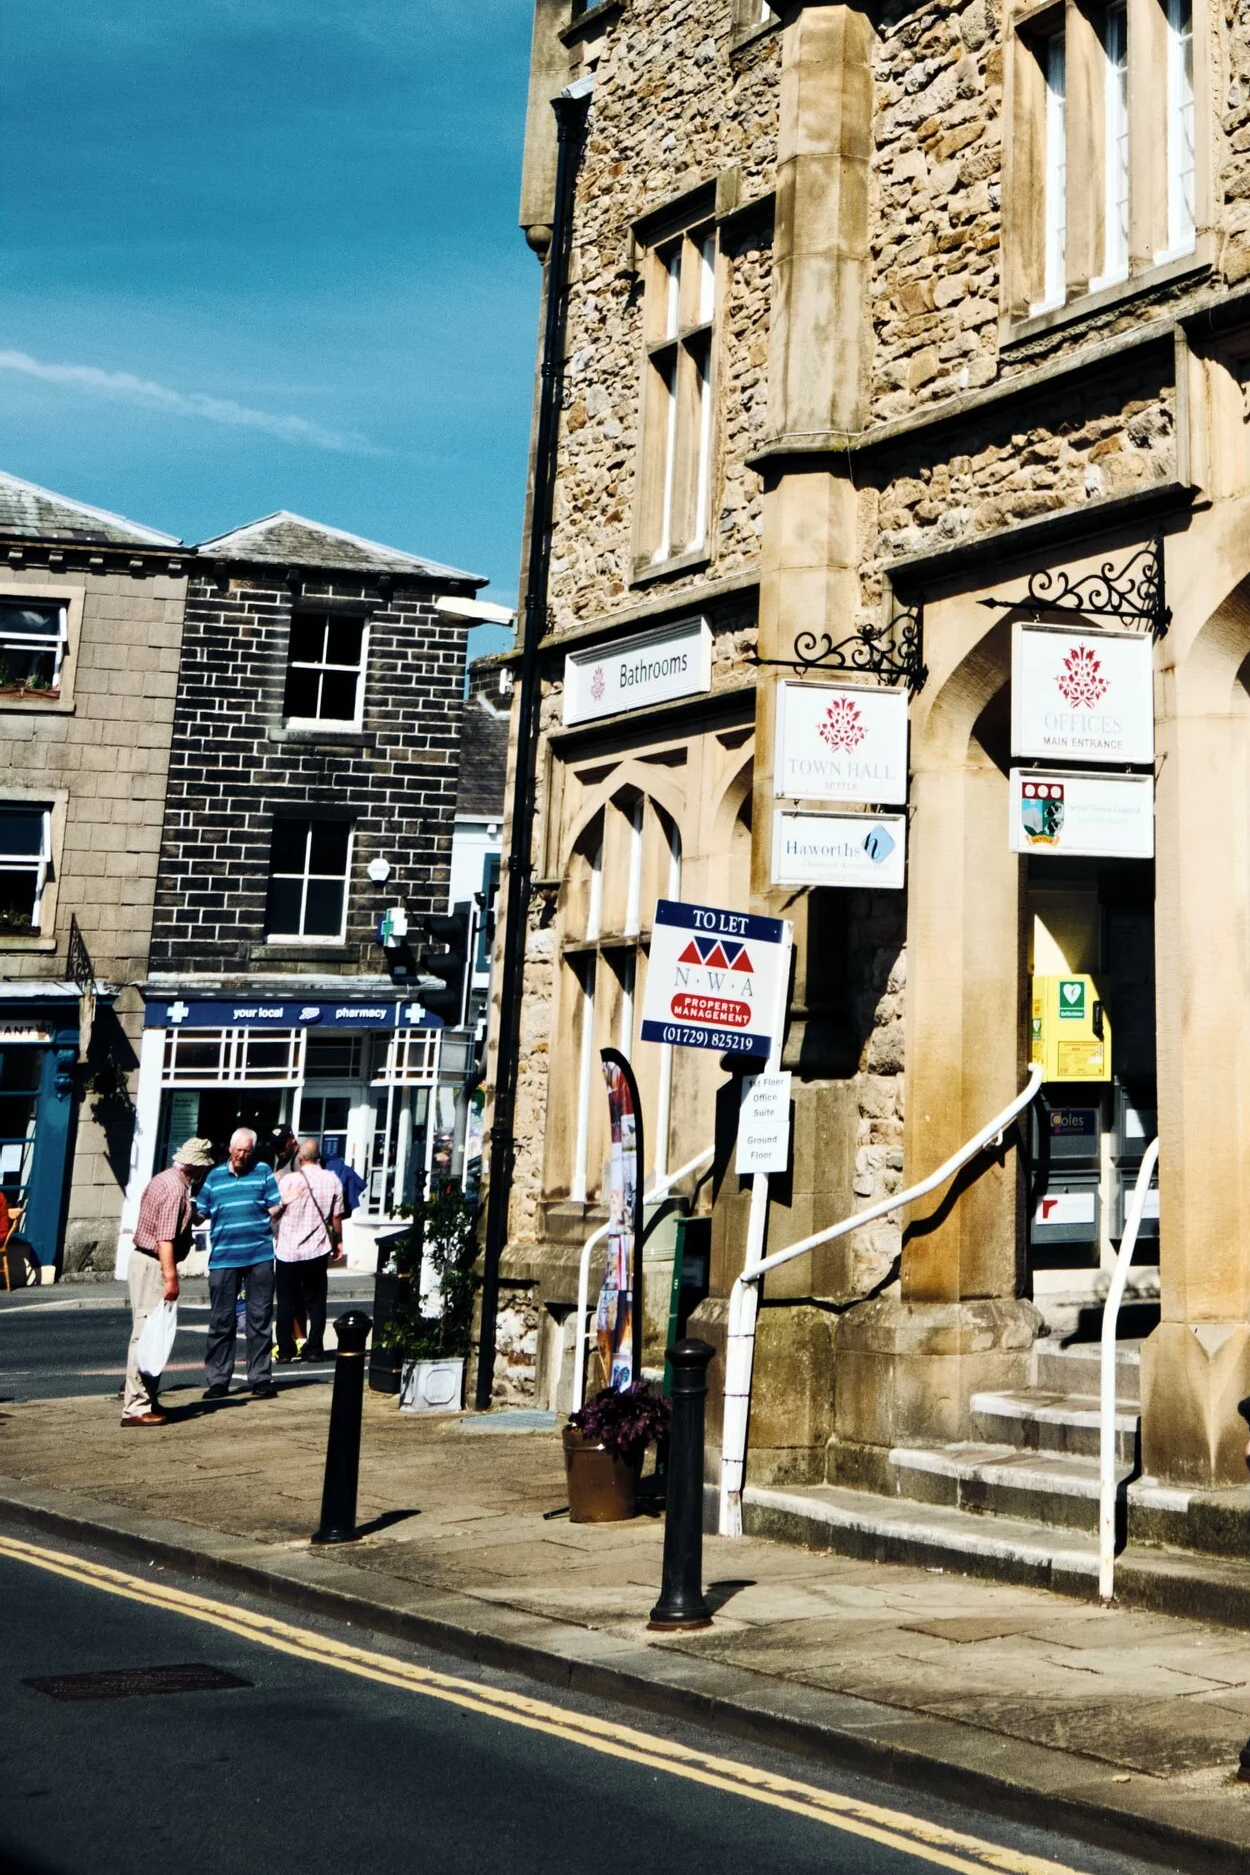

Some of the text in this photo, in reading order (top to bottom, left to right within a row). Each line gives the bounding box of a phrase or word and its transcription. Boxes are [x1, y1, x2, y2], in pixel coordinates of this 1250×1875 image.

[619, 653, 688, 689] Bathrooms
[1044, 712, 1122, 734] OFFICES
[1043, 736, 1124, 750] MAIN ENTRANCE
[788, 758, 896, 781] TOWN HALL
[785, 840, 861, 857] Haworths
[693, 910, 750, 934] TO LET
[684, 997, 742, 1012] PROPERTY
[233, 1007, 284, 1020] your local
[336, 1007, 387, 1020] pharmacy
[674, 1005, 749, 1024] MANAGEMENT
[0, 1025, 34, 1036] ANT
[662, 1026, 753, 1050] (01729) 825219
[763, 1078, 784, 1087] Floor
[753, 1093, 778, 1103] Office
[753, 1108, 776, 1117] Suite
[747, 1135, 778, 1145] Ground
[750, 1151, 773, 1160] Floor
